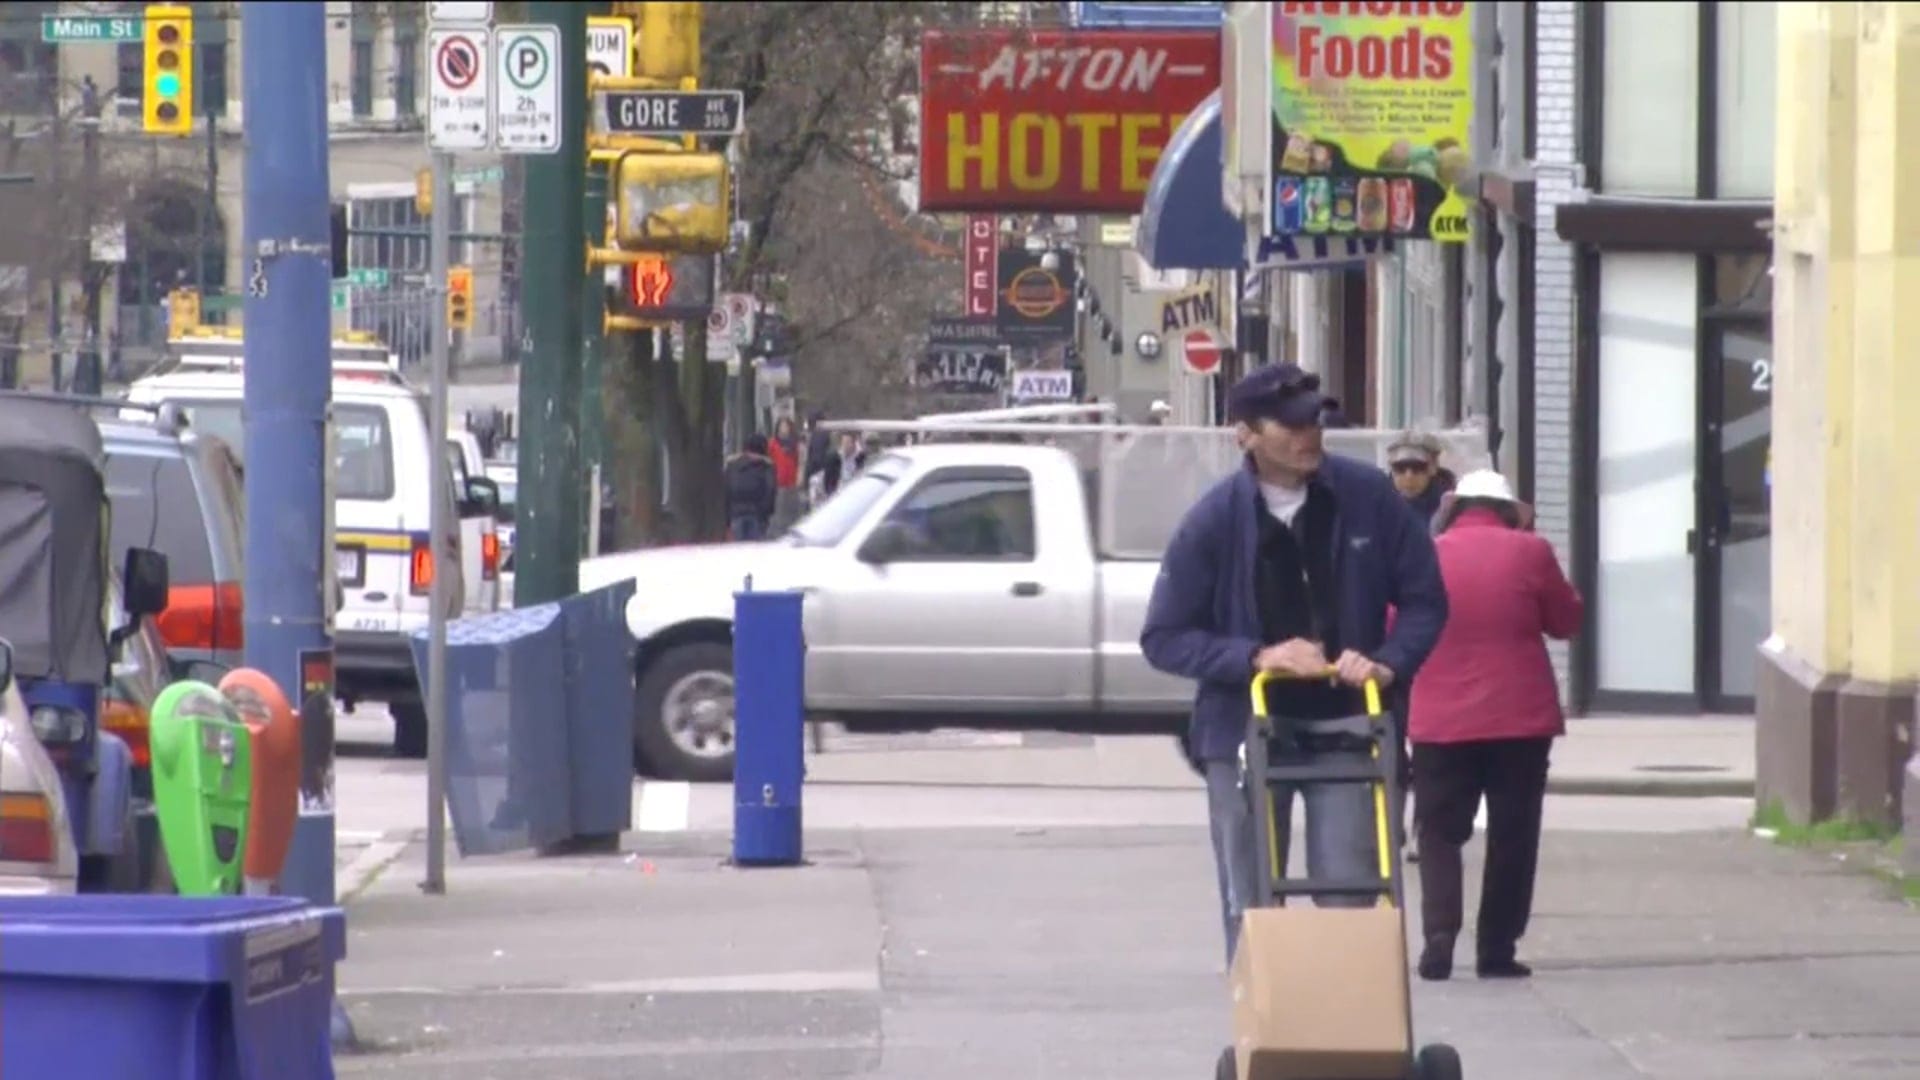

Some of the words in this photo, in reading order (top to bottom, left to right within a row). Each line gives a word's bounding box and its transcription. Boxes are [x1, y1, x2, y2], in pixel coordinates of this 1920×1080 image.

[54, 19, 101, 36] Main
[111, 19, 132, 36] St
[1299, 26, 1452, 80] Foods
[978, 46, 1167, 91] AFTON
[621, 98, 679, 127] GORE
[706, 100, 725, 113] AVE
[947, 112, 1181, 192] HOTE
[1435, 215, 1468, 233] ATM
[1162, 291, 1214, 333] ATM
[1019, 377, 1067, 394] ATM
